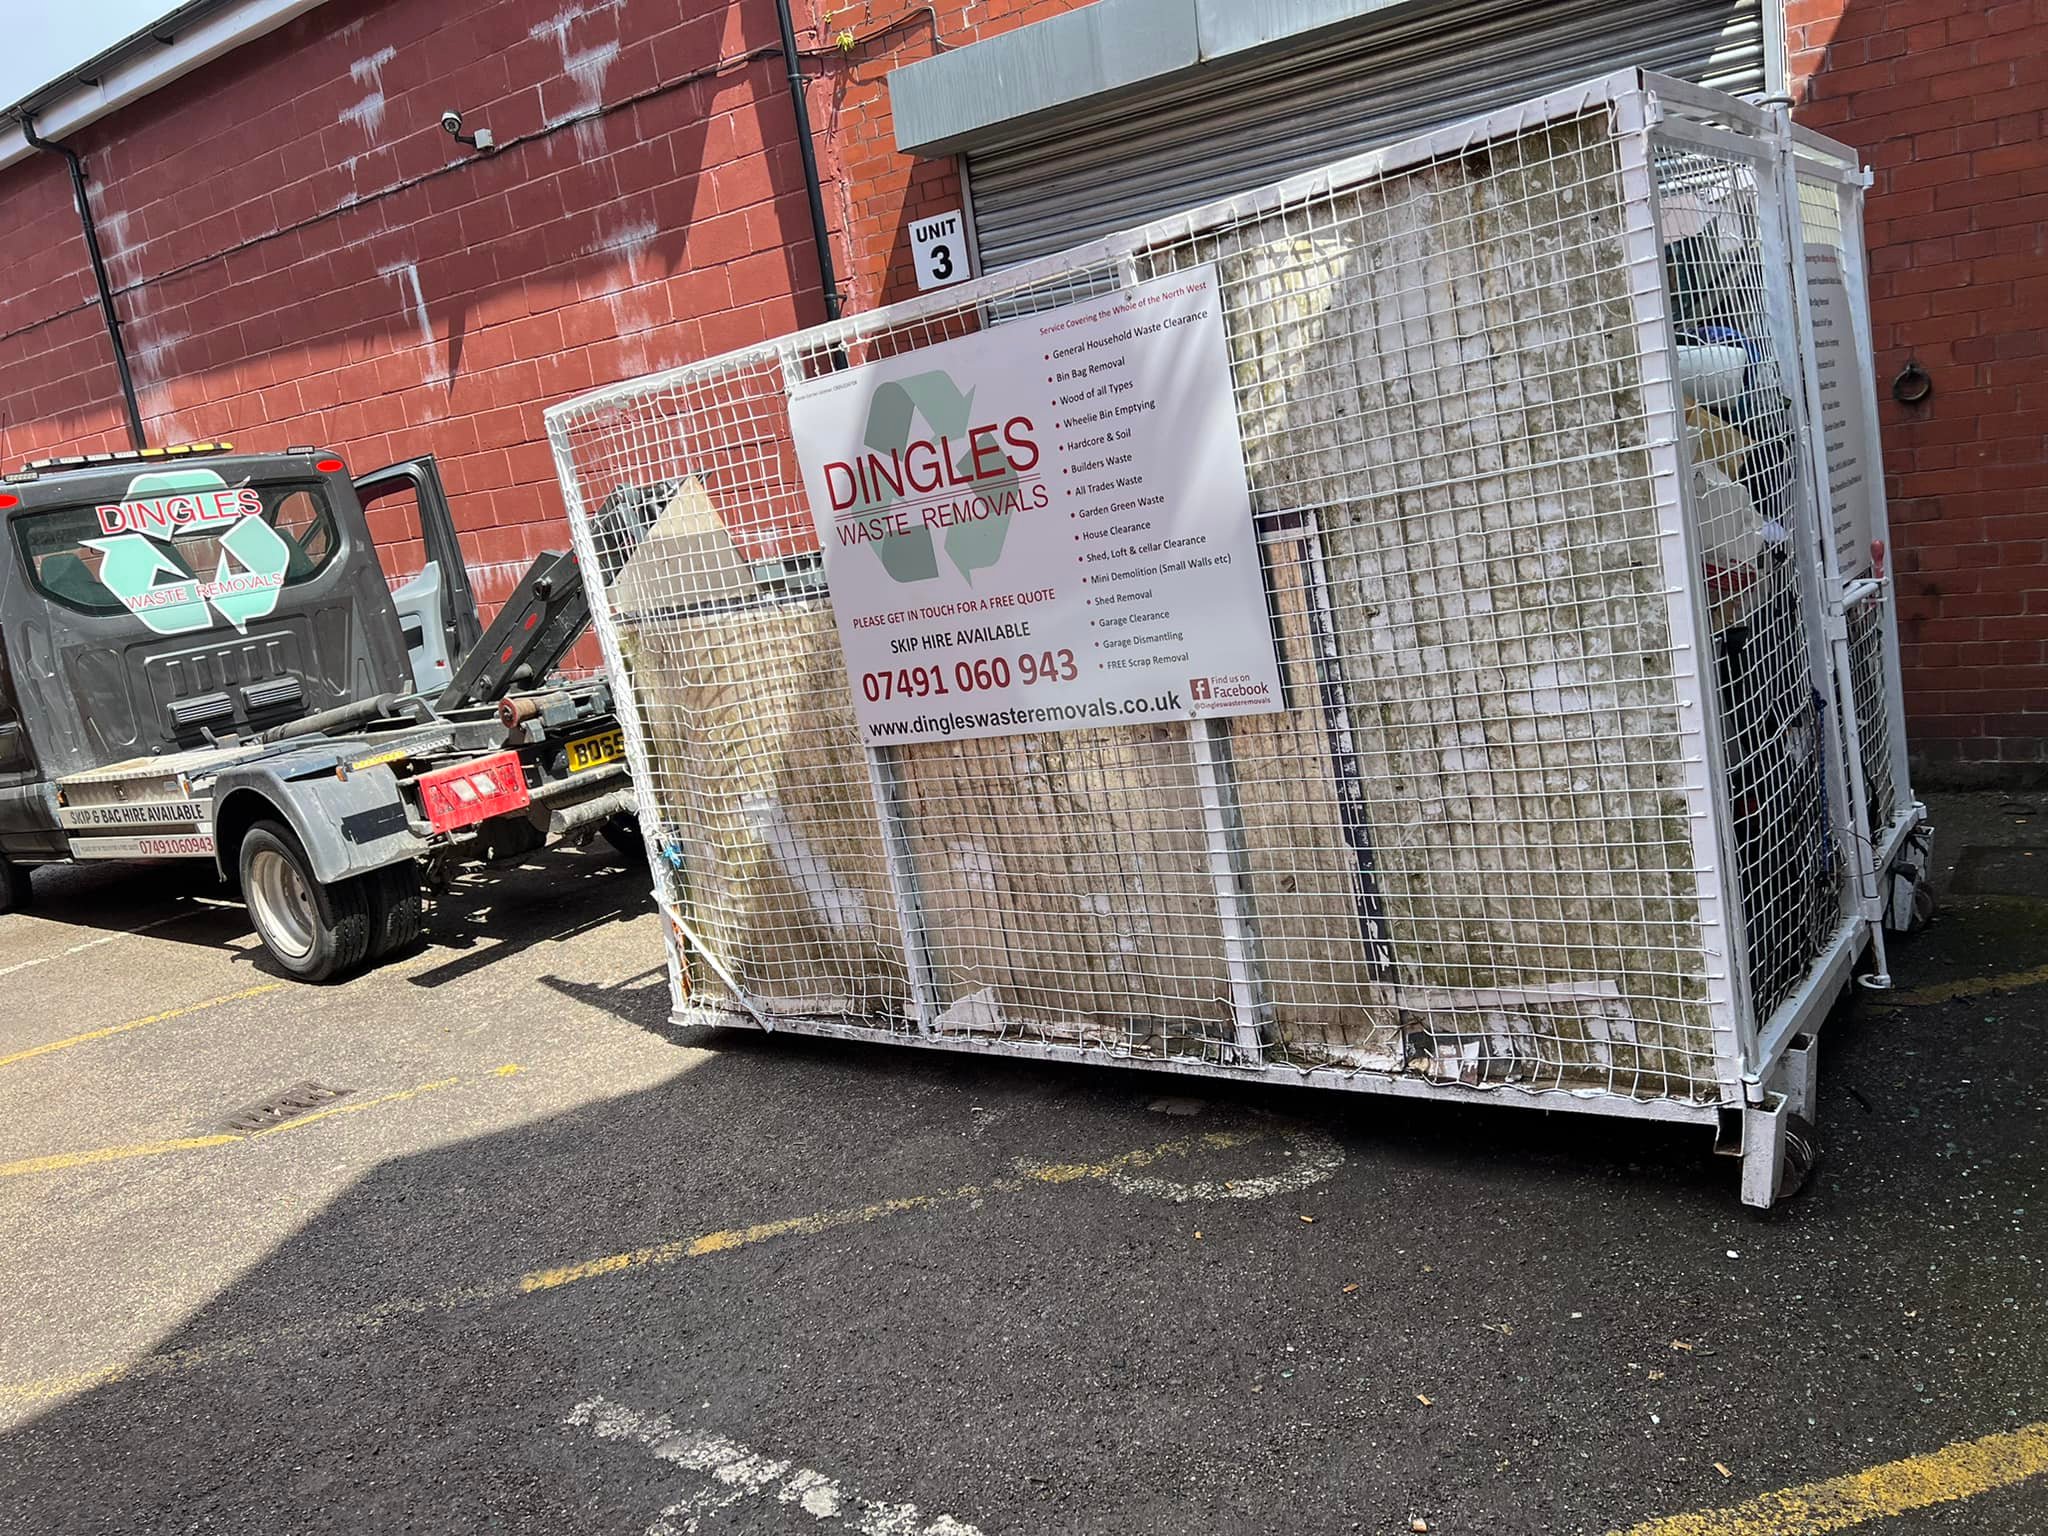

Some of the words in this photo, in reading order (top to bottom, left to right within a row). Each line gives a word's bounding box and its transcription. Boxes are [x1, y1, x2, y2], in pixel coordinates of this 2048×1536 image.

[916, 218, 956, 243] UNIT
[931, 245, 953, 279] 3
[1040, 323, 1065, 336] Service
[1066, 314, 1098, 328] Covering
[1099, 308, 1111, 319] the
[1112, 302, 1137, 315] Whole
[1138, 299, 1147, 308] of
[1148, 295, 1160, 305] the
[1162, 288, 1185, 300] North
[1186, 281, 1207, 294] West
[1053, 342, 1085, 359] General
[1087, 329, 1132, 350] Household
[1133, 323, 1161, 337] Waste
[1163, 309, 1208, 329] Clearance
[1056, 370, 1070, 382] Bin
[1072, 365, 1087, 379] Bag
[1088, 356, 1125, 373] Removal
[1060, 391, 1085, 405] Wood
[1086, 388, 1095, 397] of
[1097, 385, 1107, 396] all
[1109, 380, 1133, 394] Types
[1063, 413, 1097, 428] Wheelie
[1099, 409, 1113, 420] Bin
[1115, 399, 1155, 416] Emptying
[1067, 435, 1105, 451] Hardcore
[1106, 432, 1114, 442] &
[1115, 428, 1131, 440] Soil
[823, 416, 1039, 511] DINGLES
[1071, 460, 1104, 474] Builders
[1105, 454, 1132, 466] Waste
[1075, 486, 1086, 496] All
[1088, 481, 1115, 493] Trades
[1116, 476, 1143, 487] Waste
[96, 488, 263, 535] DINGLES
[836, 512, 911, 546] WASTE
[922, 484, 1049, 530] REMOVALS
[1079, 505, 1109, 518] Garden
[1111, 500, 1136, 513] Green
[1137, 494, 1165, 507] Waste
[1083, 528, 1108, 541] House
[1110, 520, 1151, 536] Clearance
[1086, 551, 1110, 563] Shed,
[1111, 547, 1128, 559] Loft
[1129, 546, 1137, 555] &
[1138, 542, 1161, 554] cellar
[1163, 534, 1206, 550] Clearance
[1091, 572, 1109, 584] Mini
[1111, 565, 1157, 581] Demolition
[1159, 560, 1186, 575] (Small
[1188, 556, 1213, 569] Walls
[1214, 553, 1232, 566] etc)
[124, 587, 187, 609] WASTE
[195, 573, 284, 598] REMOVALS
[1095, 594, 1115, 606] Shed
[1116, 589, 1152, 603] Removal
[853, 615, 886, 629] PLEASE
[887, 612, 905, 624] GET
[907, 610, 918, 621] IN
[920, 605, 955, 620] TOUCH
[957, 601, 978, 614] FOR
[980, 599, 989, 610] A
[990, 595, 1015, 608] FREE
[1017, 588, 1056, 606] QUOTE
[1098, 616, 1128, 628] Garage
[1129, 610, 1170, 623] Clearance
[890, 637, 918, 654] SKIP
[922, 633, 953, 650] HIRE
[956, 621, 1031, 646] AVAILABLE
[1102, 638, 1132, 650] Garage
[1133, 631, 1184, 644] Dismantling
[1107, 659, 1127, 670] FREE
[1129, 657, 1151, 669] Scrap
[1152, 652, 1189, 665] Removal
[862, 665, 949, 702] 07491
[954, 657, 1011, 692] 060
[1018, 649, 1079, 685] 943
[1211, 675, 1228, 685] Find
[1229, 675, 1238, 683] us
[1240, 674, 1250, 682] on
[1213, 681, 1269, 699] Facebook
[868, 690, 1182, 737] www.dingleswasteremovals.co.uk
[70, 810, 91, 825] SKIP
[93, 811, 101, 823] &
[101, 808, 123, 824] BAG
[123, 807, 147, 822] HIRE
[148, 804, 205, 822] AVAILABLE
[138, 836, 214, 855] 07491060943
